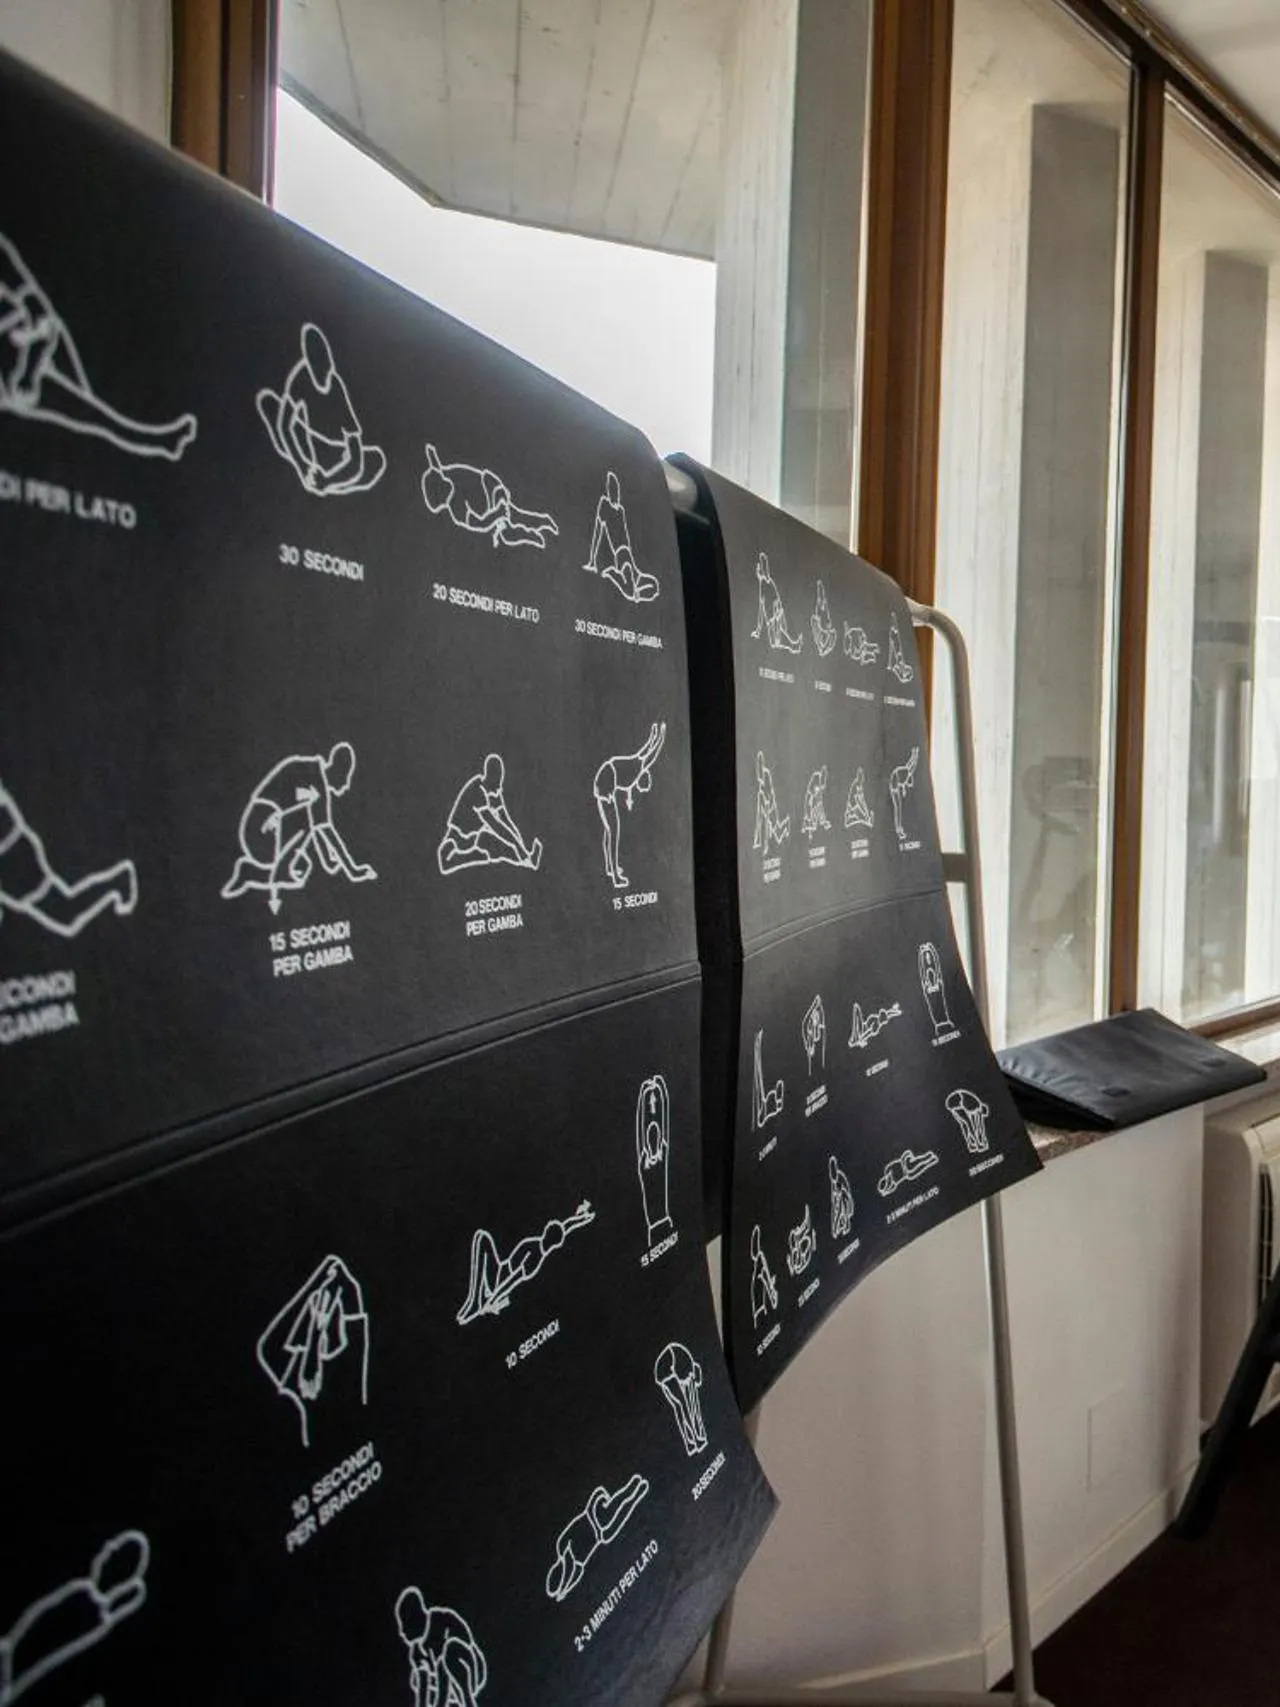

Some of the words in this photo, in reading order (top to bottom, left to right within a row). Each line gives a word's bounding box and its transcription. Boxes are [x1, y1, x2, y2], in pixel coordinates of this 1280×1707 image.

[24, 477, 71, 514] PER
[74, 490, 137, 530] LATO
[279, 543, 299, 566] 30
[303, 549, 364, 581] SECONDI
[433, 582, 447, 601] 20
[448, 587, 493, 613] SECONDI
[494, 600, 513, 617] PER
[514, 605, 540, 623] LATO
[587, 621, 622, 641] SECONDI
[465, 900, 478, 917] 20
[478, 894, 522, 914] SECONDI
[612, 897, 622, 911] 15
[624, 891, 658, 908] SECONDI
[268, 932, 286, 952] 15
[289, 920, 351, 950] SECONDI
[466, 919, 486, 937] PER
[487, 912, 524, 933] GAMBA
[272, 953, 303, 978] PER
[303, 944, 355, 971] GAMBA
[505, 1350, 518, 1369] 10
[519, 1318, 561, 1360] SECONDI
[291, 1493, 310, 1520] 10
[311, 1441, 374, 1504] SECONDI
[699, 1451, 726, 1490] SECONDI
[286, 1513, 318, 1554] PER
[318, 1460, 382, 1527] BRACCIO
[574, 1624, 593, 1653] 2-3
[589, 1586, 622, 1633] MINUTI
[618, 1565, 640, 1594] PER
[635, 1539, 659, 1573] LATO
